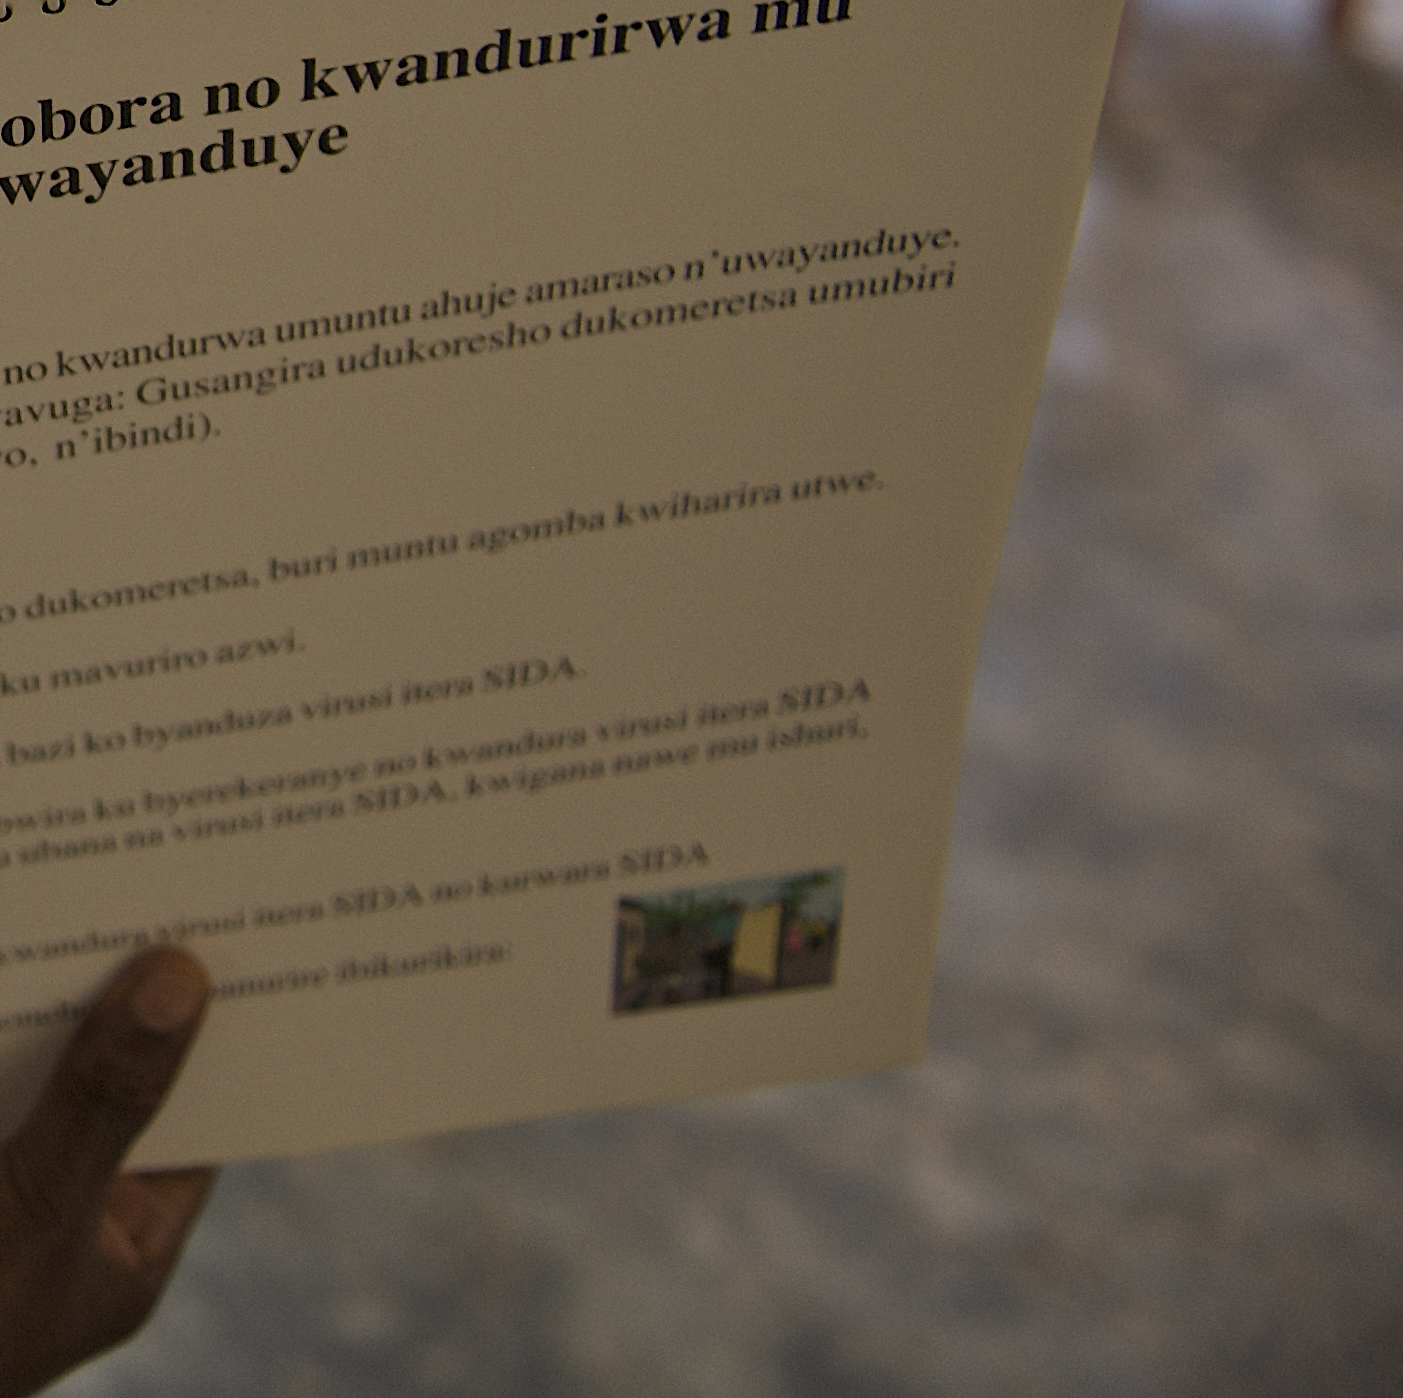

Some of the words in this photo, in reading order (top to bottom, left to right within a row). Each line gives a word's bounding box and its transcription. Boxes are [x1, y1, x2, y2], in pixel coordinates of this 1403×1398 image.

[205, 76, 280, 117] no
[301, 8, 730, 102] kwandurirwa
[4, 362, 48, 386] no
[57, 328, 265, 378] kwandurwa
[276, 304, 410, 344] umuntu
[421, 288, 516, 320] ahuje
[525, 264, 675, 304] amaraso
[136, 360, 325, 405] Gusangira
[337, 322, 551, 375] udukoresho
[560, 289, 796, 339] dukomeretsa
[809, 260, 954, 305] umubiri
[25, 570, 258, 619] dukomeretsa,
[270, 545, 337, 582] buri
[349, 535, 457, 569] muntu
[469, 510, 605, 553] agomba
[616, 486, 781, 526] kwiharira
[792, 472, 884, 500] utwe.
[0, 674, 40, 697] ku
[51, 651, 207, 689] mavuriro
[217, 628, 305, 663] azwi.
[7, 740, 75, 765] bazi
[84, 732, 126, 754] ko
[133, 708, 292, 746] byanduza
[302, 691, 392, 718] virusi
[402, 679, 474, 704] itera
[484, 657, 585, 689] SIDA.
